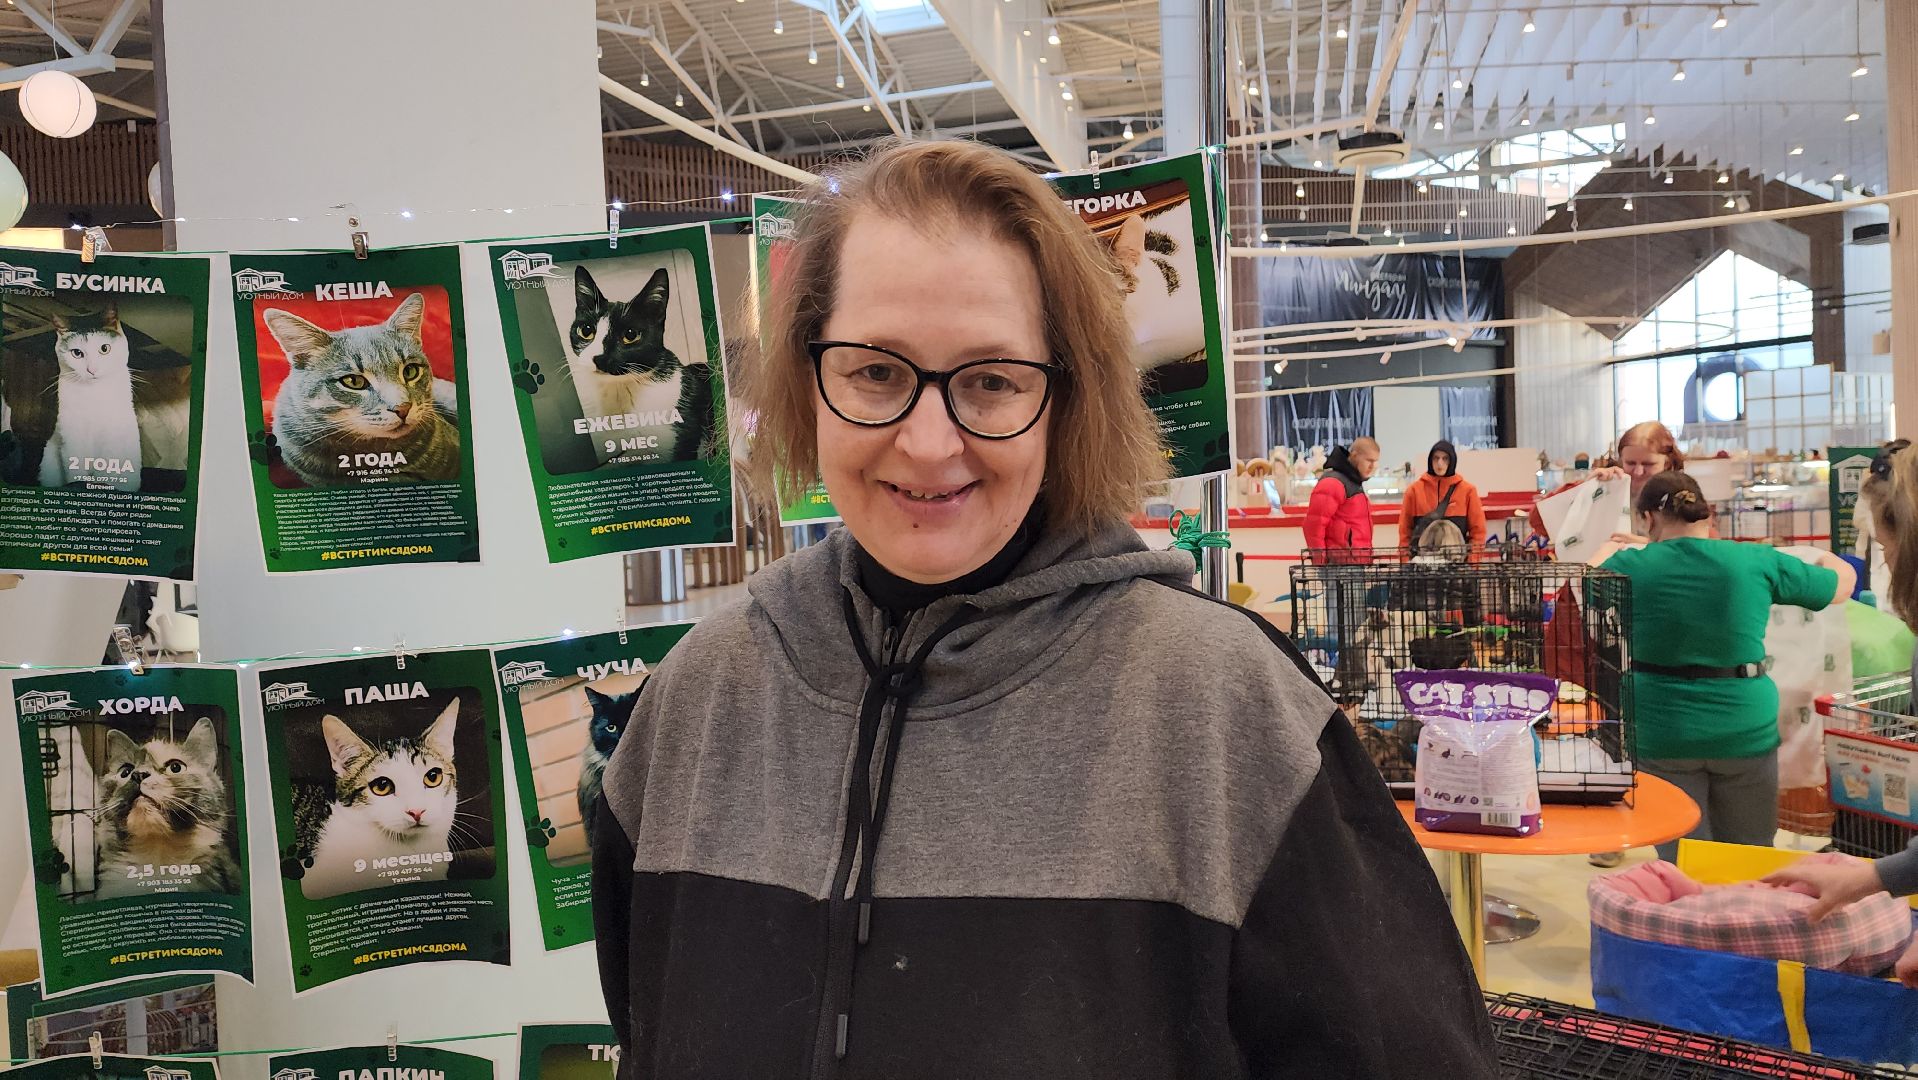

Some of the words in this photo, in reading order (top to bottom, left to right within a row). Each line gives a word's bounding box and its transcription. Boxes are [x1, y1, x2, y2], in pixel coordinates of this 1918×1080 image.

[56, 272, 166, 294] БУСИНКА
[315, 280, 394, 302] КЕША
[32, 288, 55, 297] ДОМ
[237, 292, 280, 300] УЮТНЫЙ
[282, 292, 304, 300] ДОМ
[1164, 402, 1184, 411] чтобы
[574, 408, 684, 434] ЕЖЕВИКА
[1188, 421, 1211, 429] собаки
[604, 440, 616, 452] 9
[620, 436, 658, 450] МЕС
[69, 456, 80, 470] 2
[84, 458, 134, 474] ГОДА
[338, 454, 350, 468] 2
[354, 452, 408, 468] ГОДА
[80, 508, 107, 516] Всегда
[108, 510, 128, 518] будет
[590, 516, 692, 536] #ВСТРЕТИМСЯДОМА
[0, 531, 33, 540] Хорошо
[40, 552, 149, 566] #ВСТРЕТИМСЯДОМА
[321, 545, 433, 560] #ВСТРЕТИМСЯДОМА
[576, 658, 649, 682] ЧУЧА
[344, 682, 430, 706] ПАША
[1408, 682, 1466, 705] CAT
[98, 696, 184, 716] ХОРДА
[266, 701, 304, 712] УЮТНЫЙ
[305, 698, 326, 708] ДОМ
[69, 709, 92, 719] ДОМ
[354, 858, 366, 872] 9
[372, 852, 454, 870] месяцев
[126, 864, 154, 880] 2,5
[160, 864, 202, 876] года
[332, 906, 352, 915] котик
[400, 892, 442, 902] характером!
[392, 917, 415, 926] станет
[110, 948, 224, 965] #ВСТРЕТИМСЯДОМА
[354, 942, 468, 965] #ВСТРЕТИМСЯДОМА
